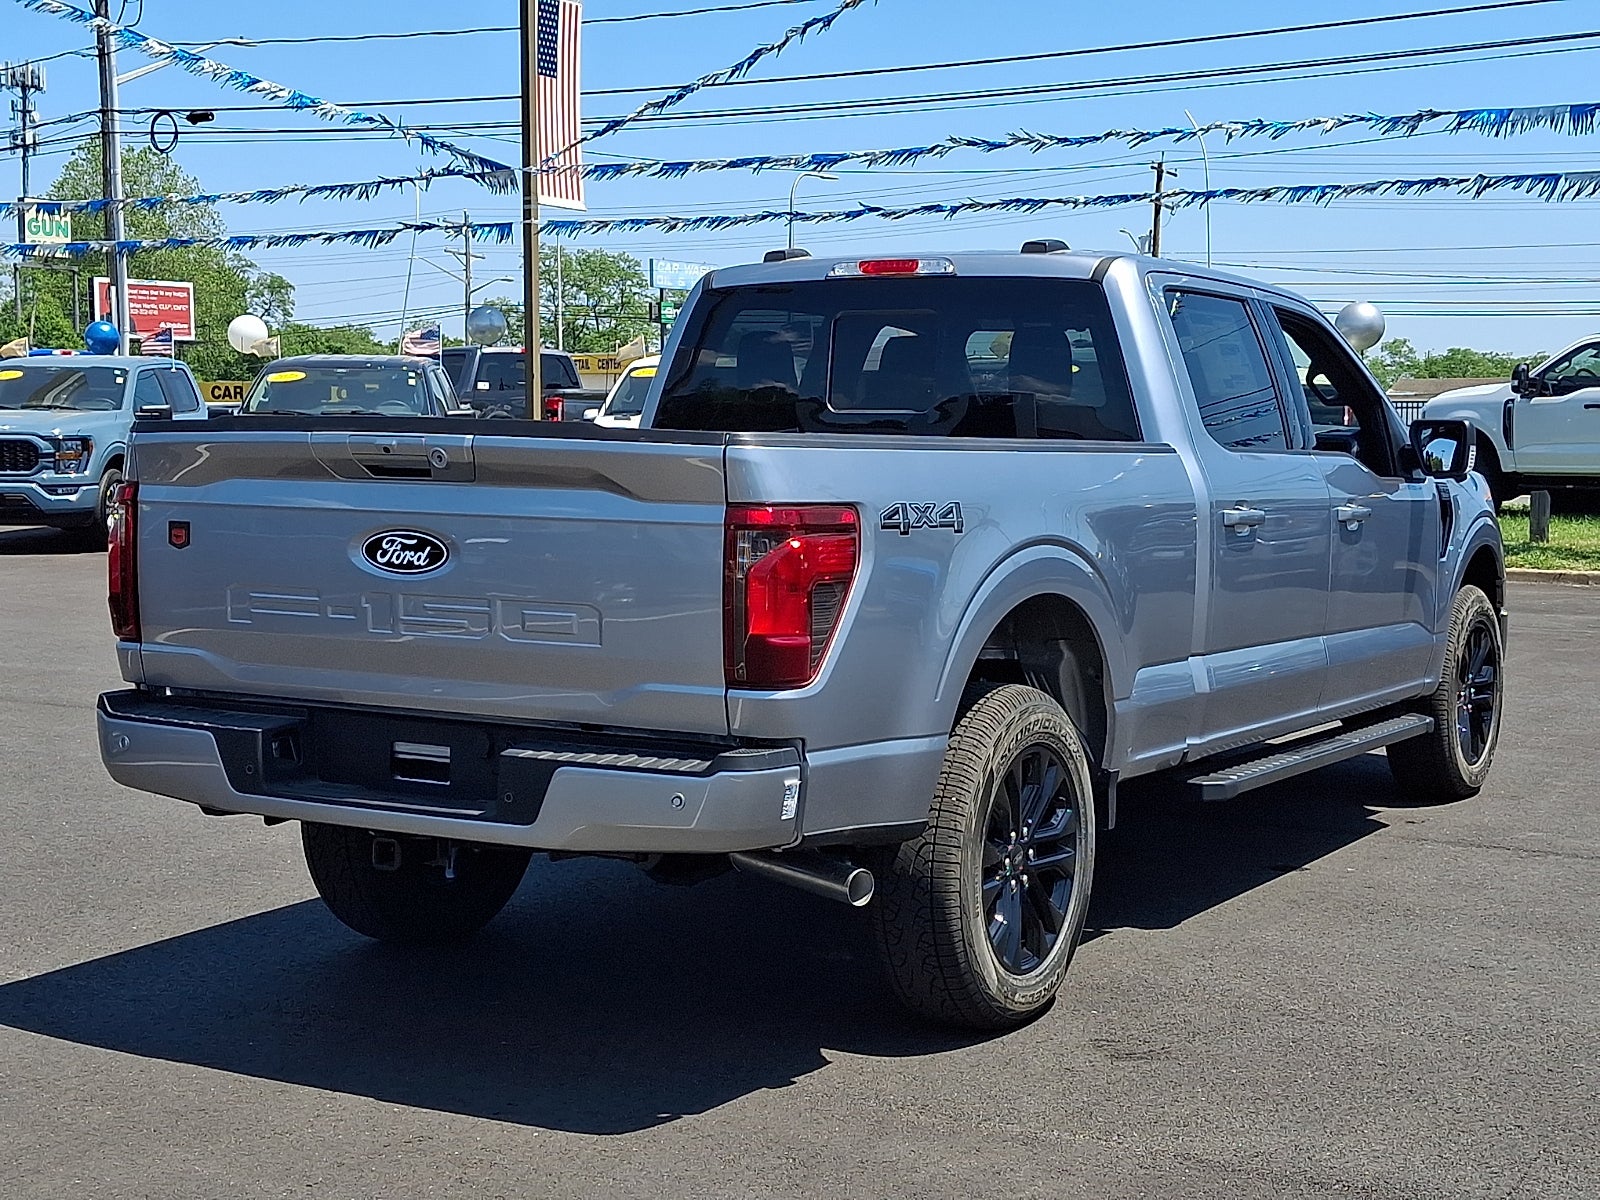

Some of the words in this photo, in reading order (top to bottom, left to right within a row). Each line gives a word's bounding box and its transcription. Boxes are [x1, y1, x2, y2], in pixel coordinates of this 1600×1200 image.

[27, 217, 69, 238] GUN
[657, 261, 680, 274] CAR
[656, 275, 673, 286] OIL
[210, 385, 244, 400] CAR
[376, 536, 431, 566] Ford
[226, 584, 603, 648] F-150
